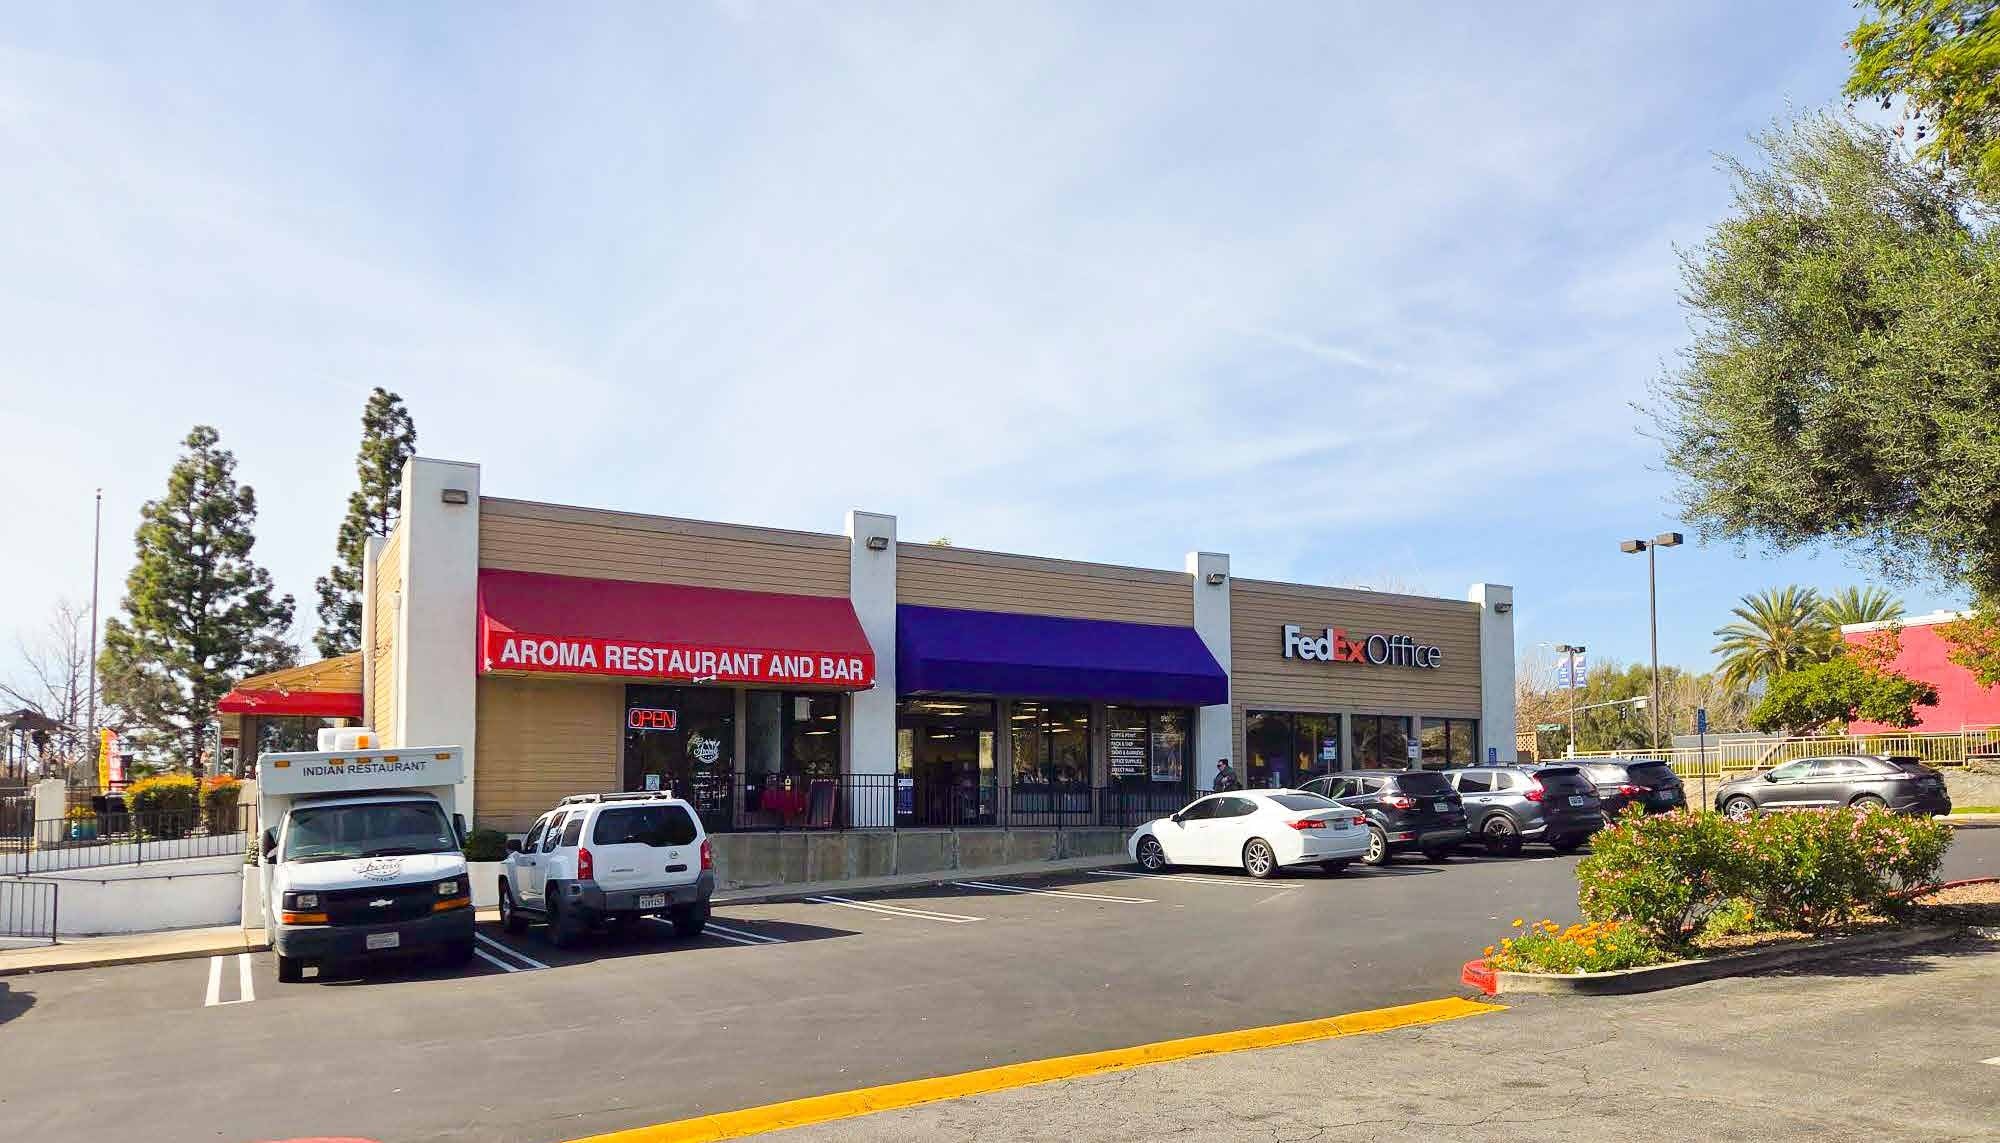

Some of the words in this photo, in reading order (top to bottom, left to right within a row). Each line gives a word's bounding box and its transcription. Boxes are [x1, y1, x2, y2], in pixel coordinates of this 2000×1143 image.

[501, 639, 598, 668] AROMA
[605, 645, 763, 676] RESTAURANT
[768, 654, 814, 678] AND
[820, 657, 864, 681] BAR
[1282, 624, 1366, 664] FedEx
[1368, 634, 1441, 668] Office
[630, 709, 675, 728] OPEN
[303, 766, 344, 776] INDIAN
[347, 761, 427, 774] RESTAURANT
